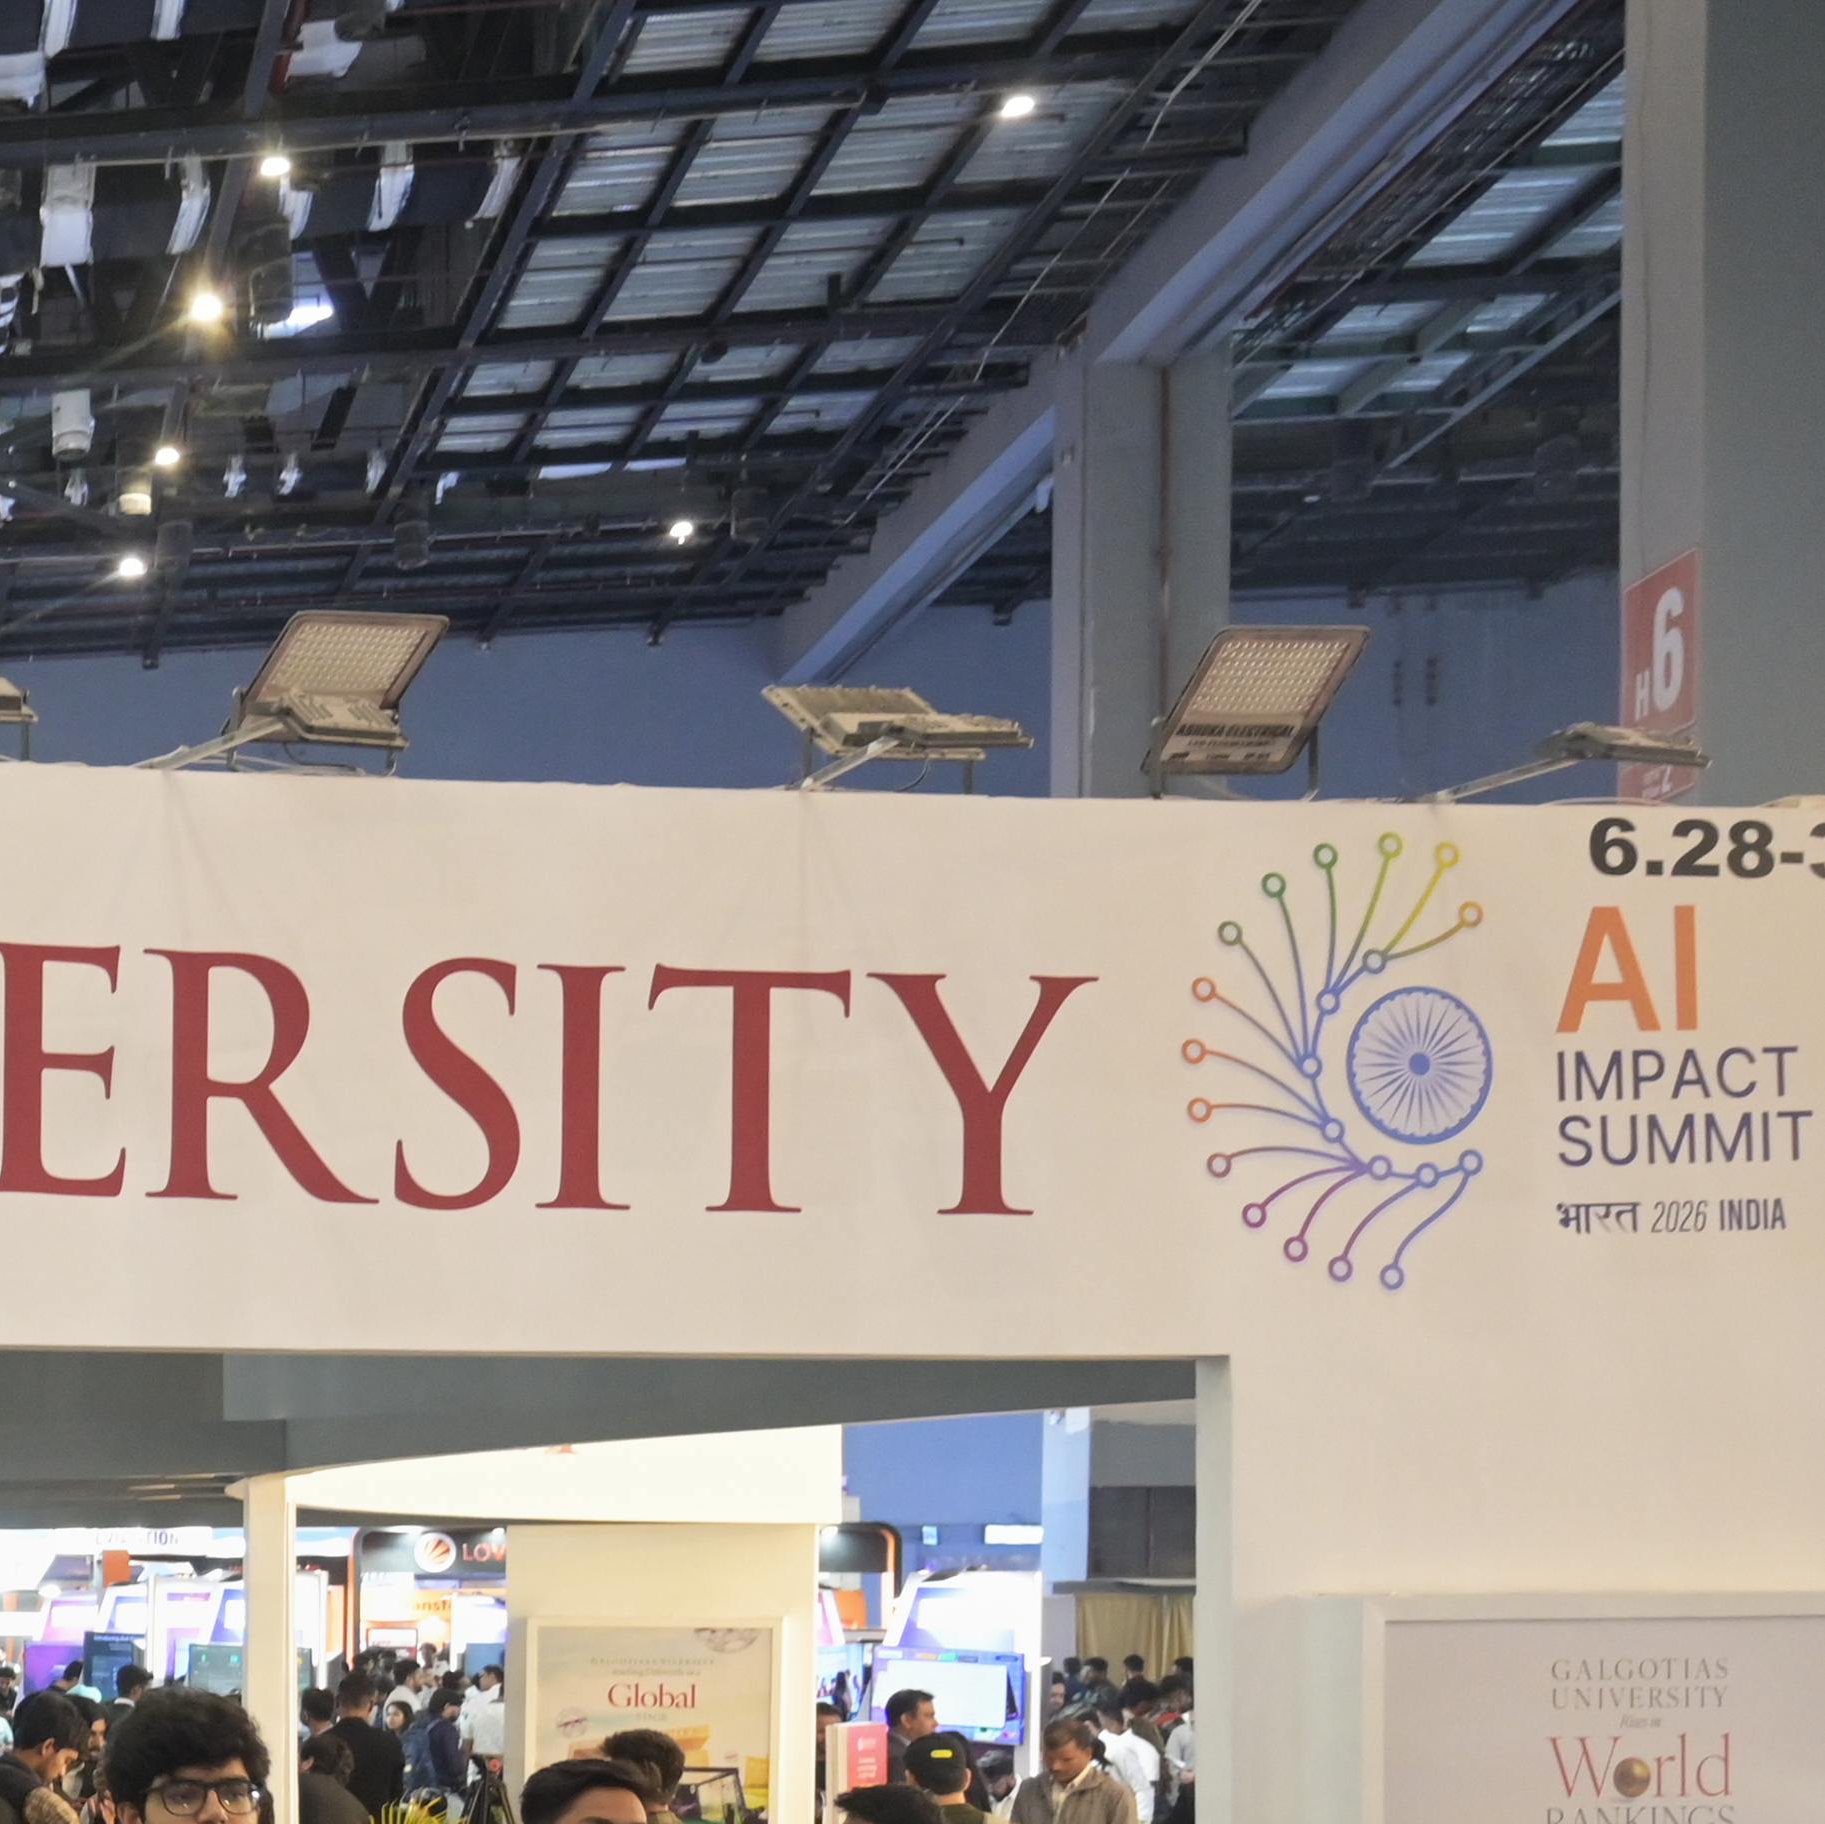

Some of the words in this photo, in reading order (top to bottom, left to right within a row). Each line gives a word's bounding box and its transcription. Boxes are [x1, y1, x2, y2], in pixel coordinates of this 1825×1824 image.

[1556, 904, 1698, 1033] AI
[1557, 1046, 1799, 1102] IMPACT
[1558, 1110, 1813, 1167] SUMMIT
[1556, 1201, 1642, 1234] भारत
[1651, 1200, 1708, 1233] 2026
[1719, 1198, 1787, 1231] INDIA
[1551, 1657, 1729, 1681] GALGOTIAS
[607, 1682, 697, 1709] Global
[1551, 1685, 1728, 1710] UNIVERSITY
[1546, 1731, 1733, 1799] World
